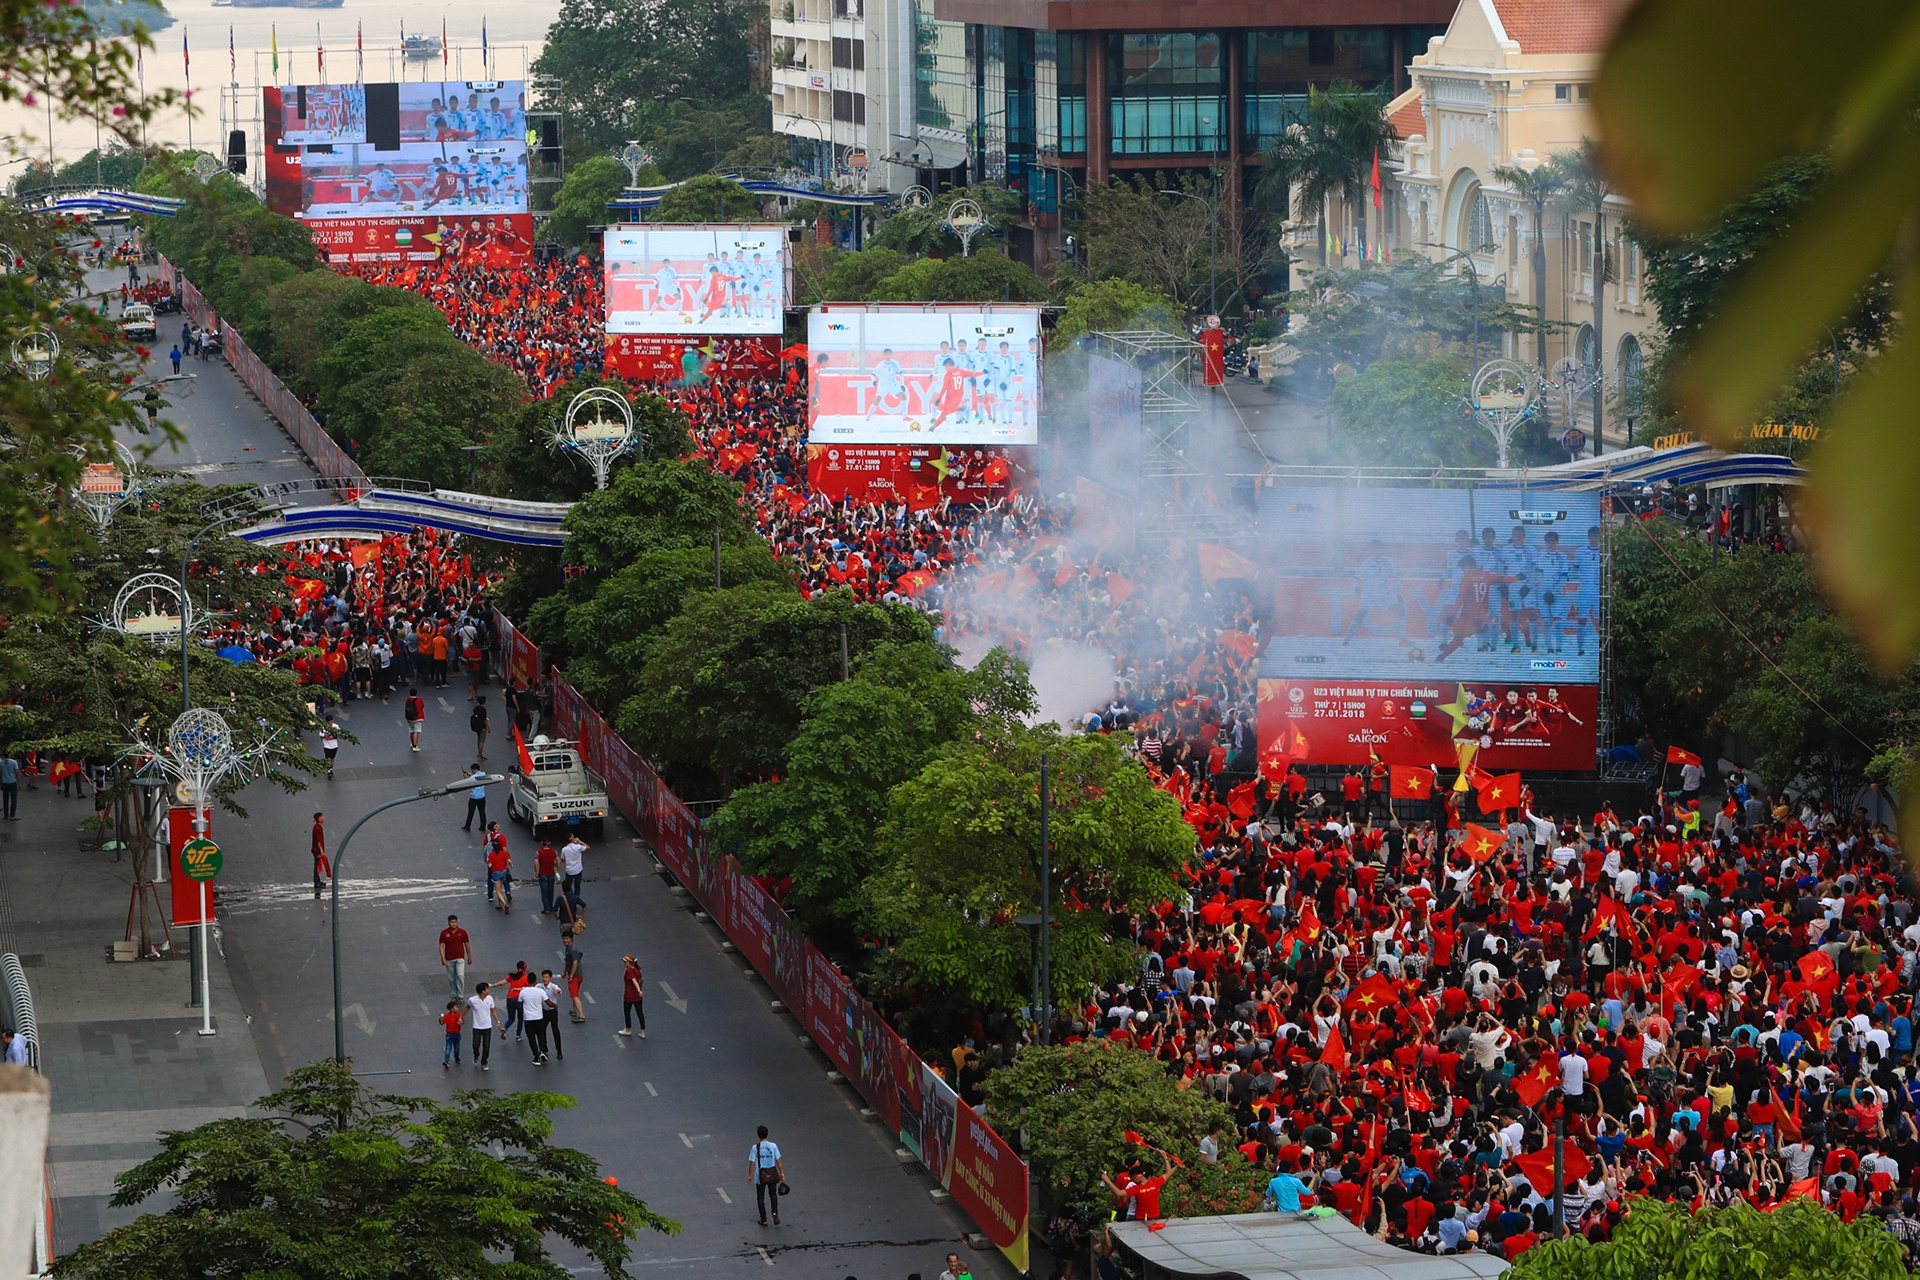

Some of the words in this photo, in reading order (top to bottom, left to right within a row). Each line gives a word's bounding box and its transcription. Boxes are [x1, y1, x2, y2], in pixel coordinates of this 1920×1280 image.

[446, 176, 456, 186] 19
[340, 219, 356, 227] NAM
[311, 235, 353, 244] 27.01.2018
[717, 280, 725, 292] 19
[952, 376, 962, 391] 19
[1749, 419, 1785, 439] NĂM
[1653, 428, 1694, 452] CHÚC
[855, 449, 867, 458] VIỆT
[867, 449, 879, 457] NAM
[887, 449, 896, 457] TIN
[1472, 582, 1488, 603] 19
[1533, 660, 1567, 669] mobiTV
[1313, 687, 1328, 697] U23
[1329, 686, 1345, 699] VIỆT
[1346, 687, 1364, 697] NAM
[1365, 688, 1376, 699] TỰ
[1377, 688, 1389, 698] TIN
[1390, 686, 1413, 698] CHIẾN
[1414, 687, 1439, 699] THẮNG
[1314, 701, 1329, 709] THỨ
[1314, 709, 1365, 718] 27.01.2018
[1348, 734, 1388, 744] SAIGON
[552, 799, 594, 809] SUZUKI
[186, 846, 218, 865] VTP
[982, 1163, 995, 1188] HÀO
[955, 1156, 966, 1179] BAY
[965, 1168, 980, 1198] CÙNG
[984, 1189, 991, 1208] 23
[991, 1196, 1003, 1221] VIỆT
[1002, 1208, 1016, 1235] NAM
